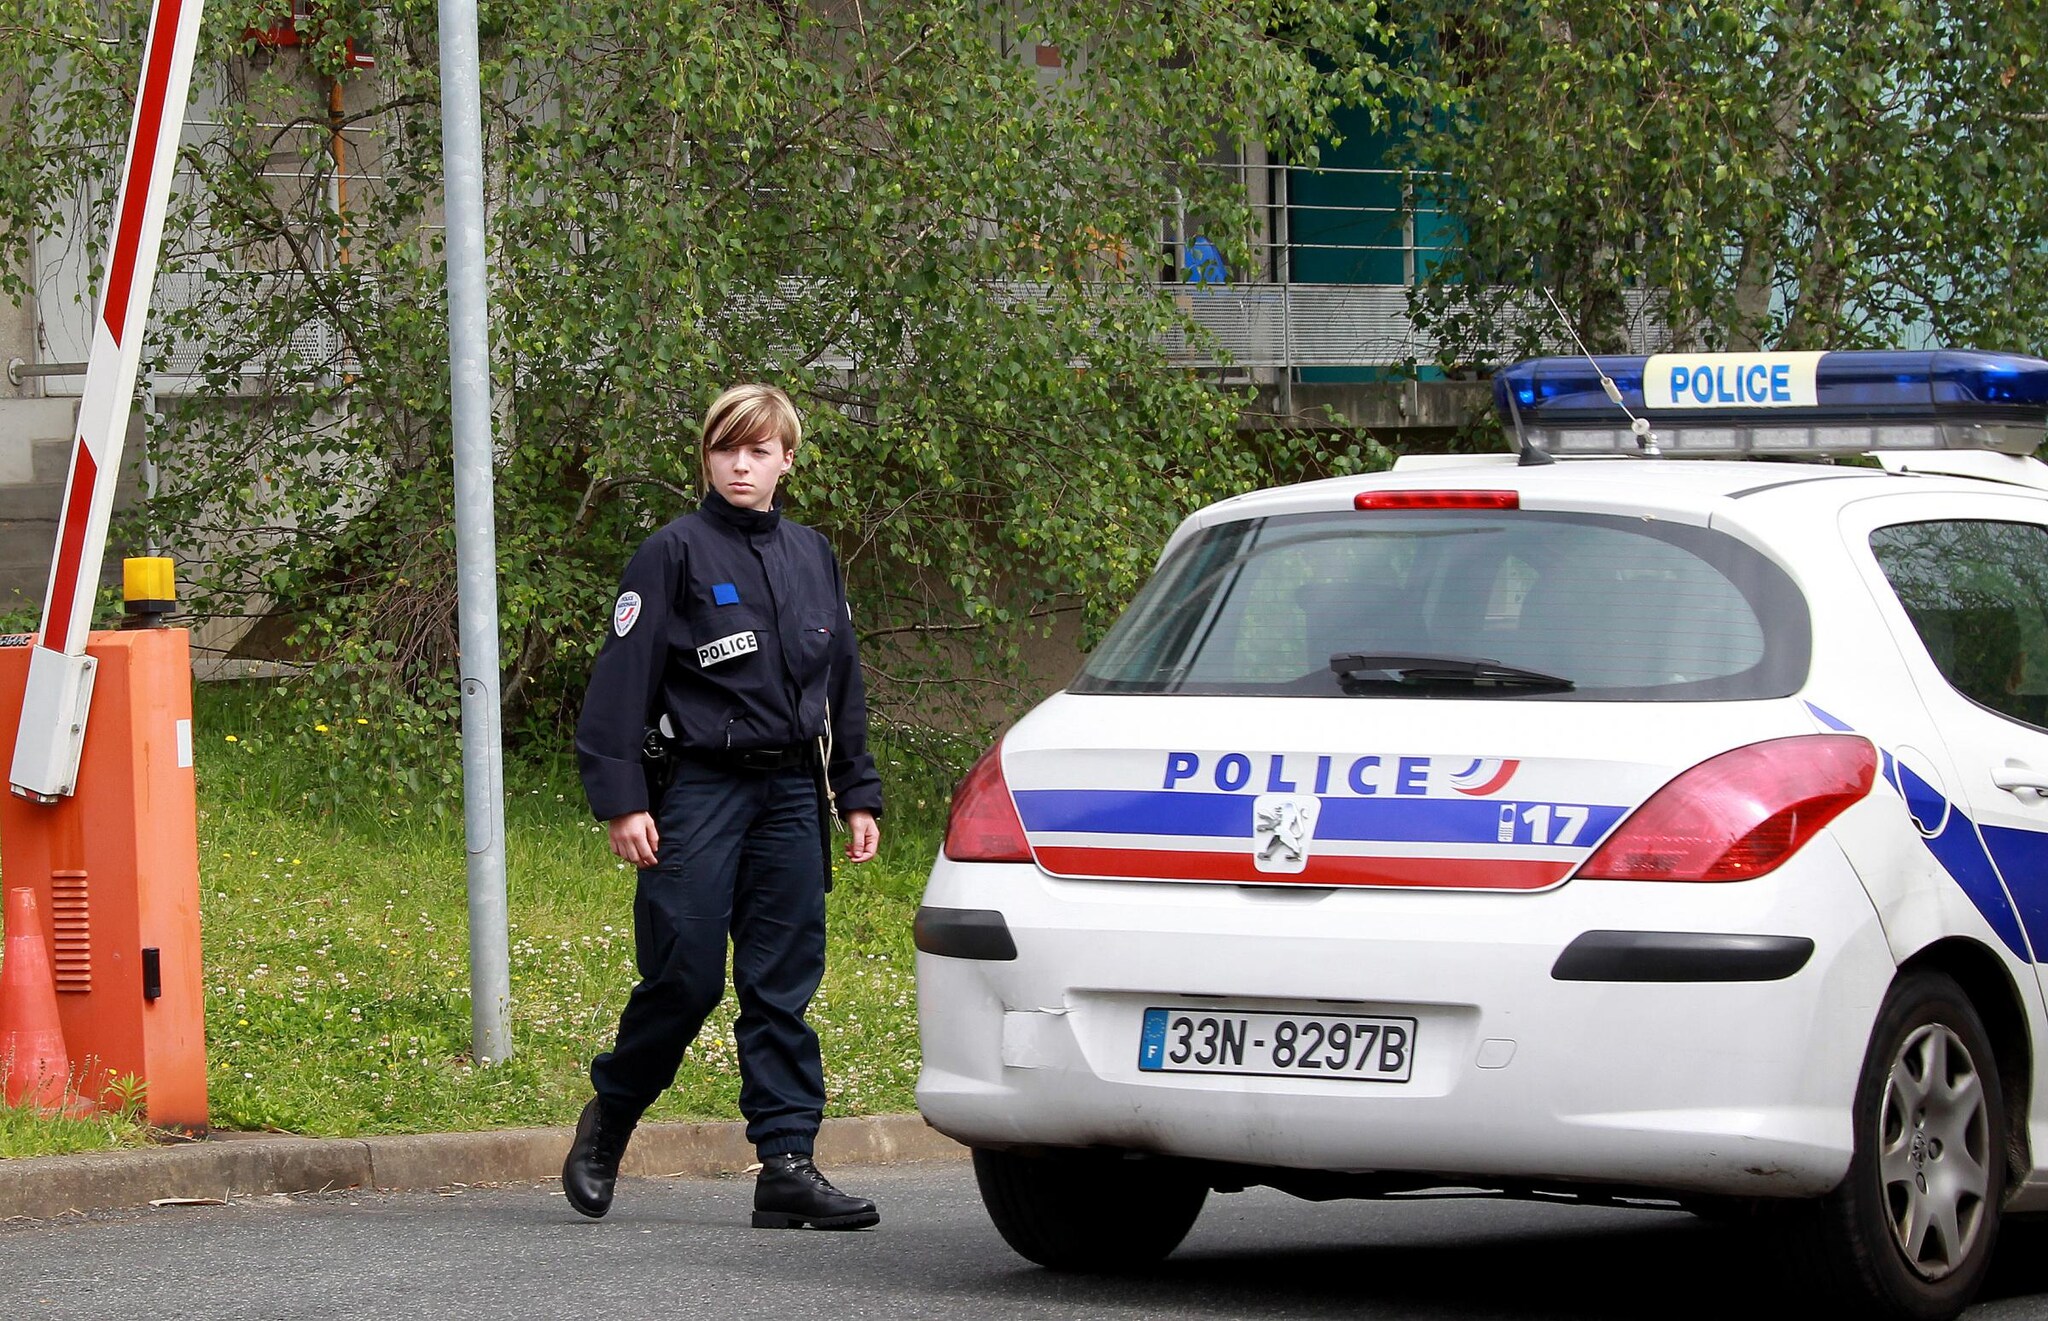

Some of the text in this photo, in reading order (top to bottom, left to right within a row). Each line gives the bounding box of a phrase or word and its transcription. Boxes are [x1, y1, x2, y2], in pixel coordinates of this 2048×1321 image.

[1671, 364, 1790, 403] POLICE
[699, 634, 757, 664] POLICE
[1163, 752, 1430, 796] POLICE
[1521, 805, 1589, 844] 17
[1147, 1045, 1158, 1059] F
[1169, 1016, 1406, 1072] 33N-8297B
